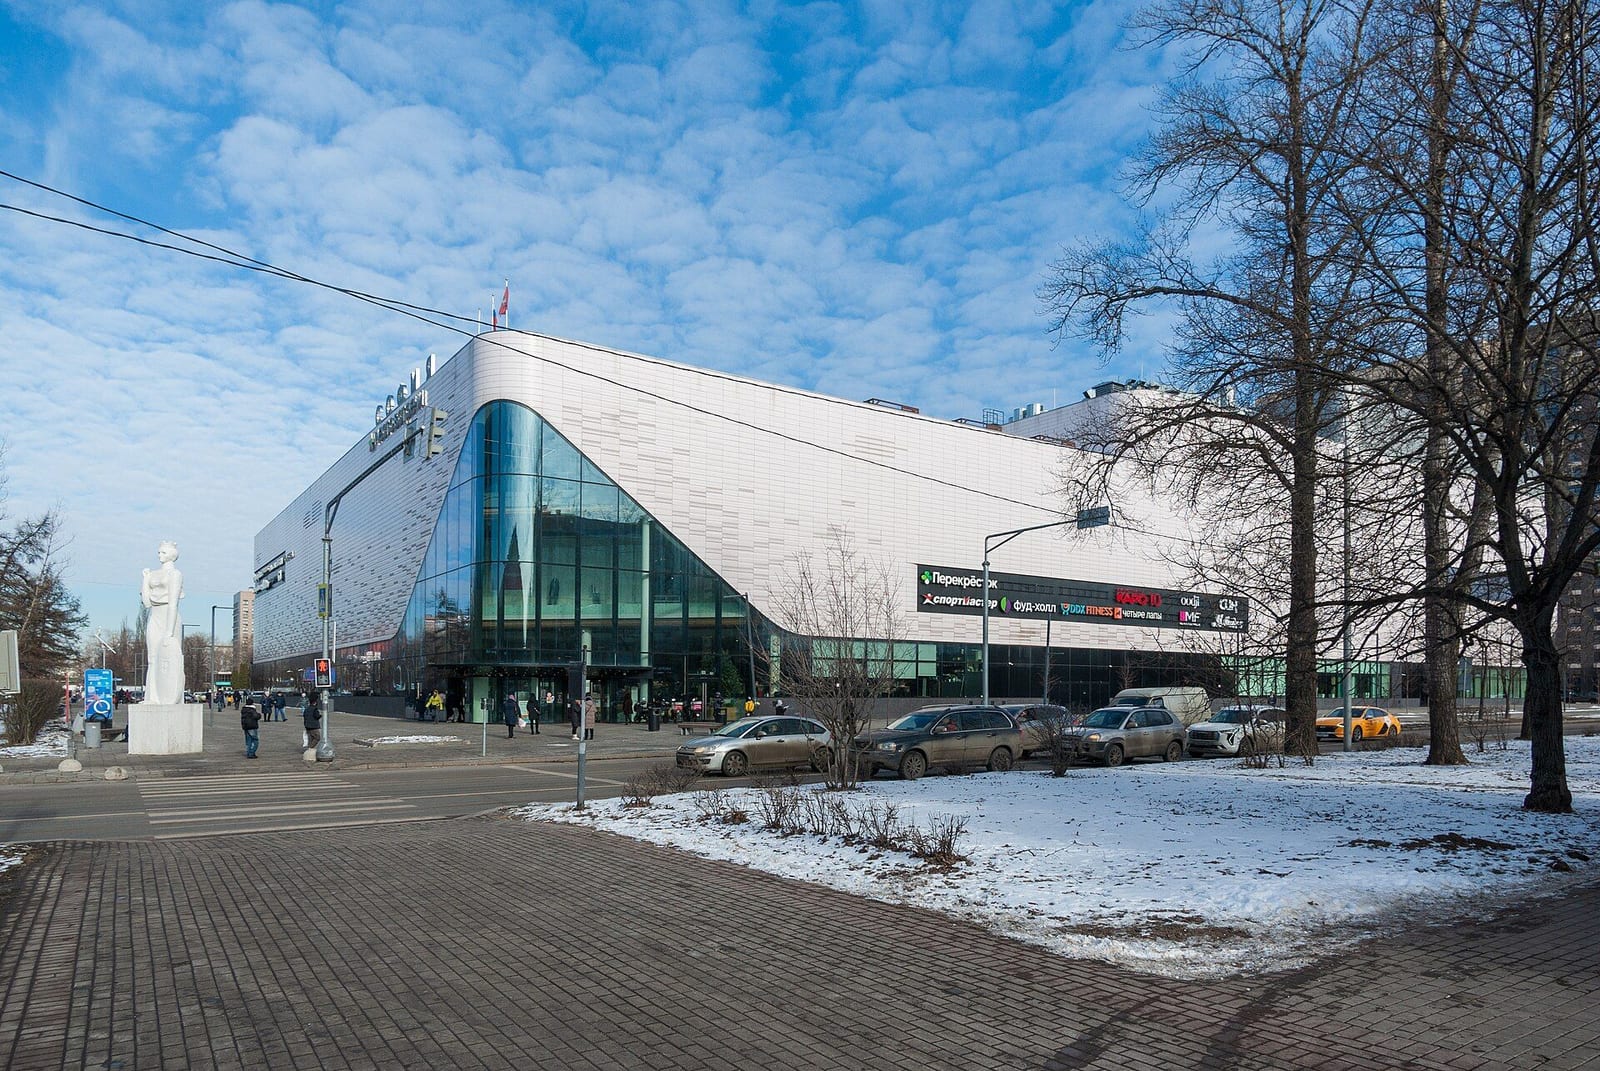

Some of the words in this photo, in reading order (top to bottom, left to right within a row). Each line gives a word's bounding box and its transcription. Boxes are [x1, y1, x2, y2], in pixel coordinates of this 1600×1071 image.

[932, 571, 998, 589] Перекрёсок
[1070, 604, 1085, 615] DDX
[1086, 605, 1113, 616] FITNESS
